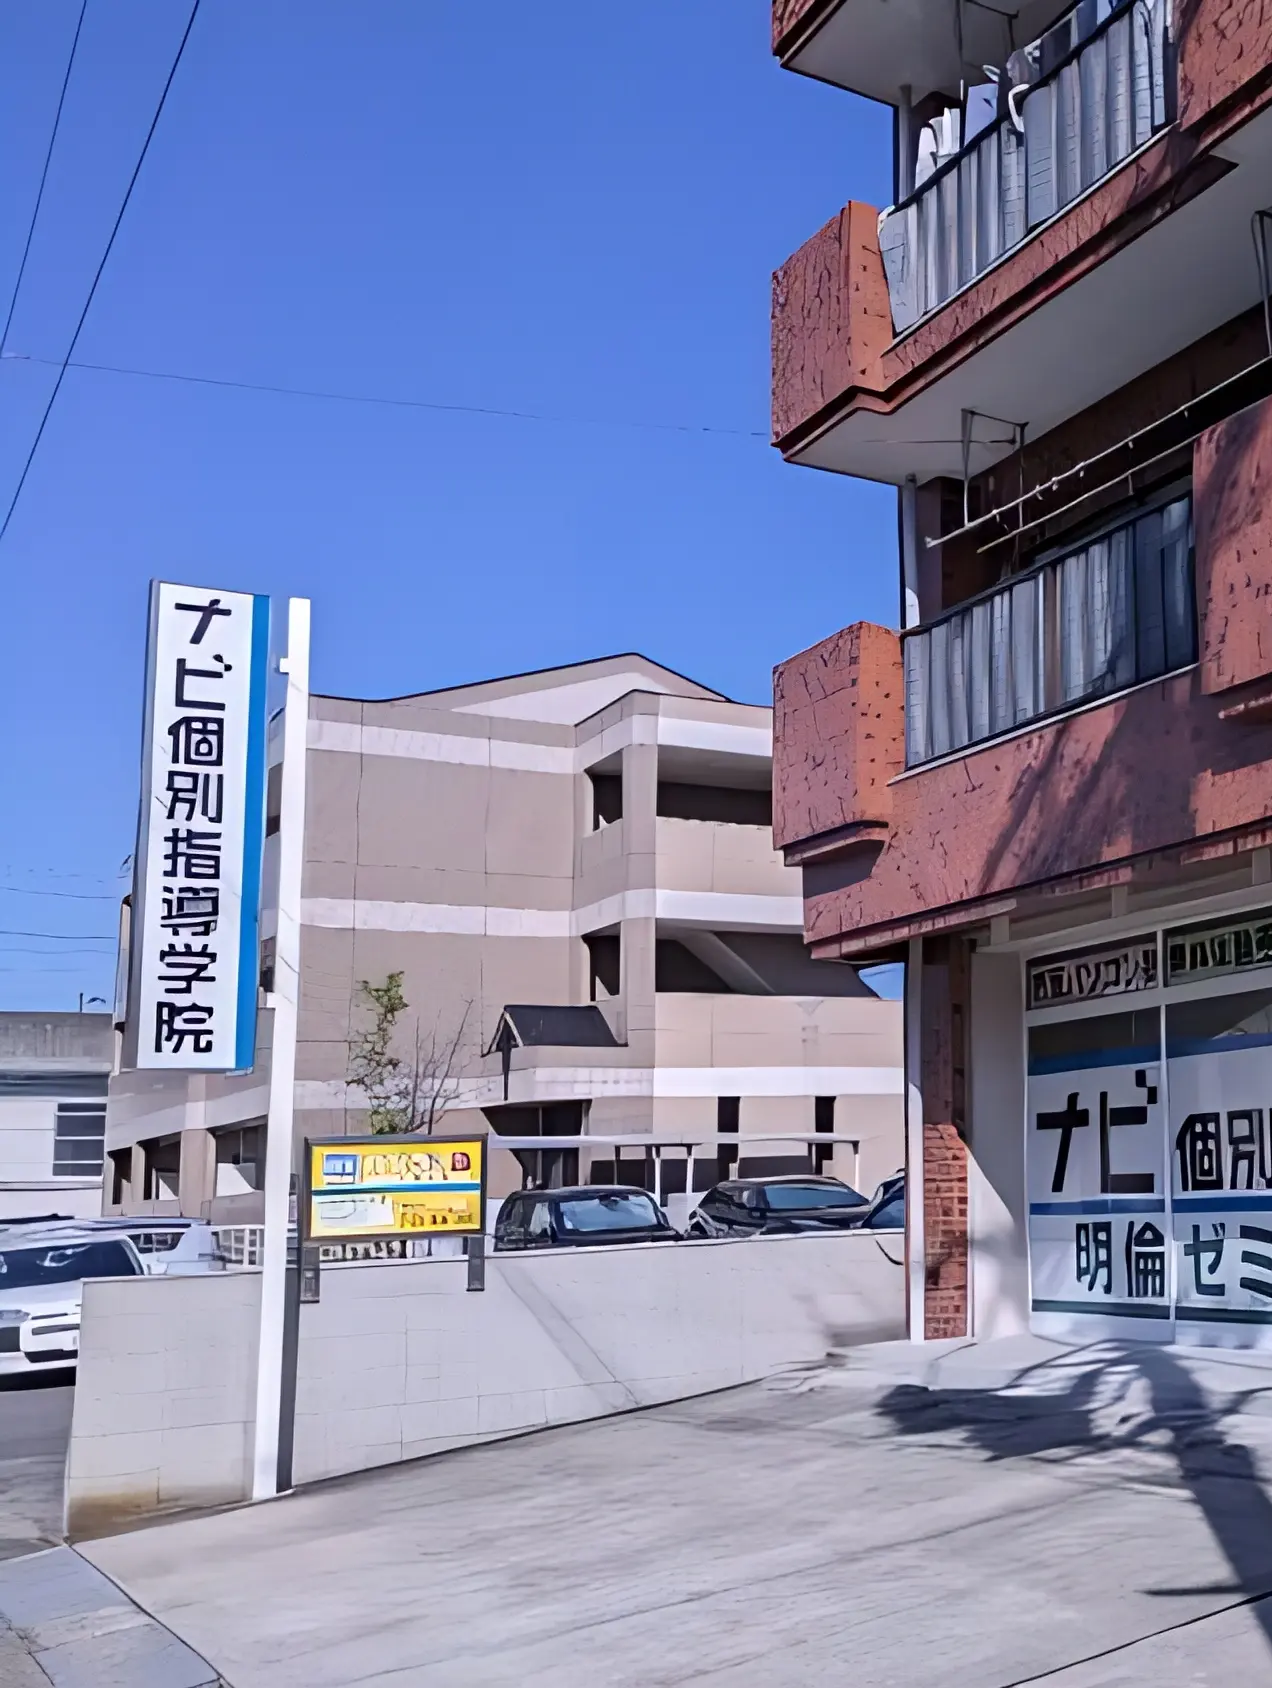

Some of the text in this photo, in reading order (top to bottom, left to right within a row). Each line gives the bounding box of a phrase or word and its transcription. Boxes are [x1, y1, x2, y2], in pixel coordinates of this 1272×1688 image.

[155, 598, 233, 1054] ナビ個別指導学院
